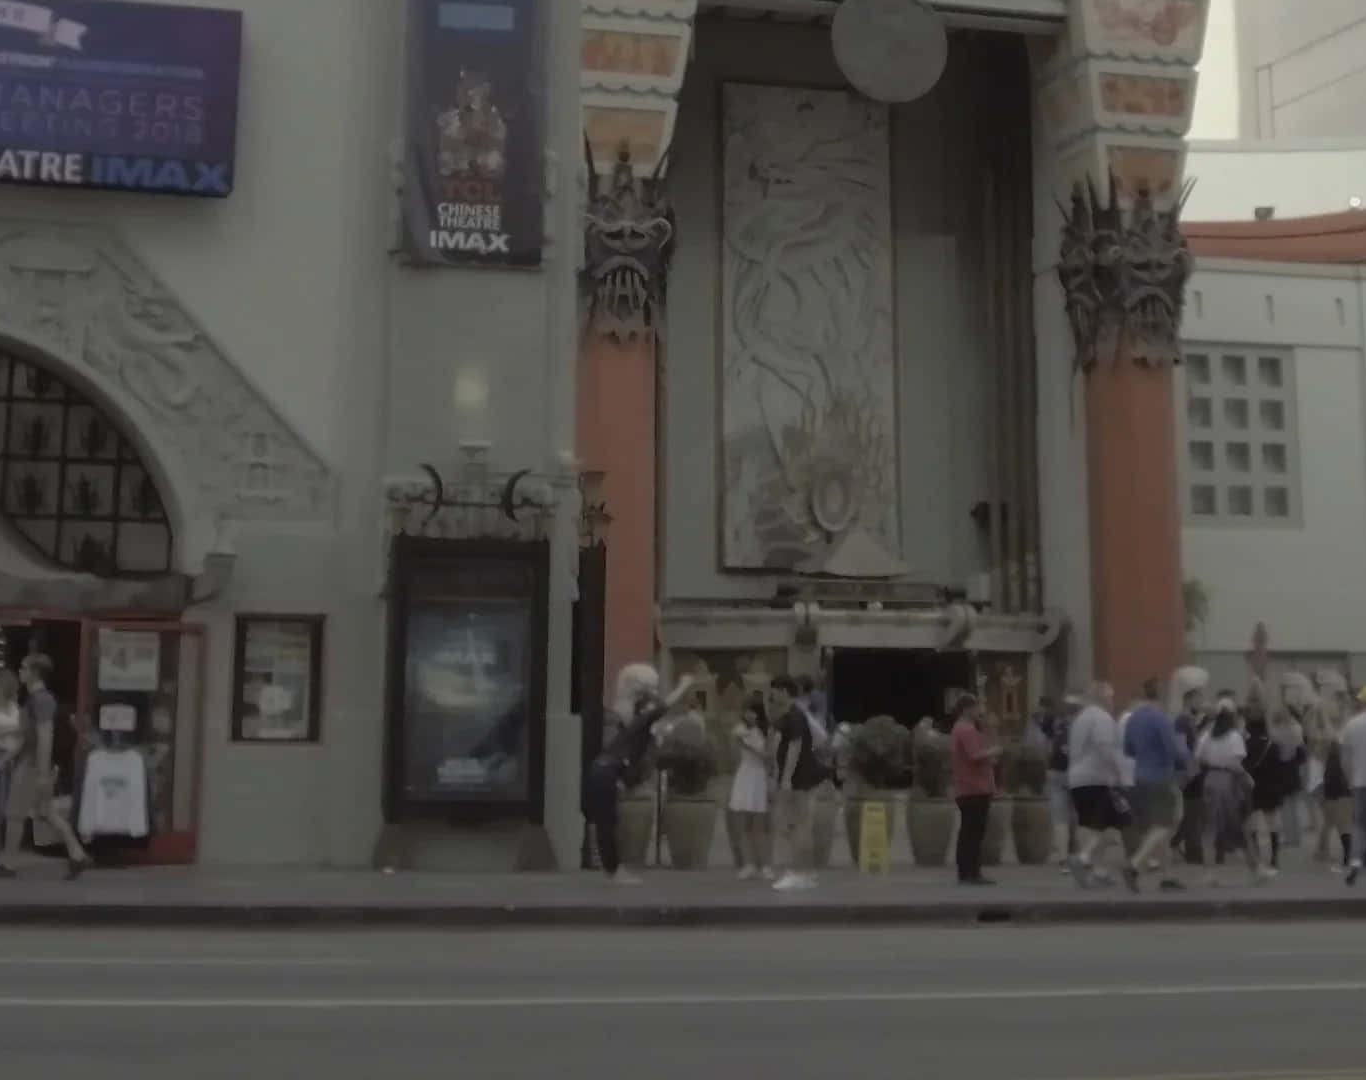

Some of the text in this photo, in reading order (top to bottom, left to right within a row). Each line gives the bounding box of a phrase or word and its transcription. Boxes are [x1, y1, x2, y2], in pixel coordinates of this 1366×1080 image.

[131, 120, 203, 144] 2018
[92, 157, 229, 191] IMAX
[443, 181, 501, 202] TCL
[437, 202, 500, 218] CHINESE
[438, 216, 500, 230] THEATRE
[430, 231, 510, 252] IMAX
